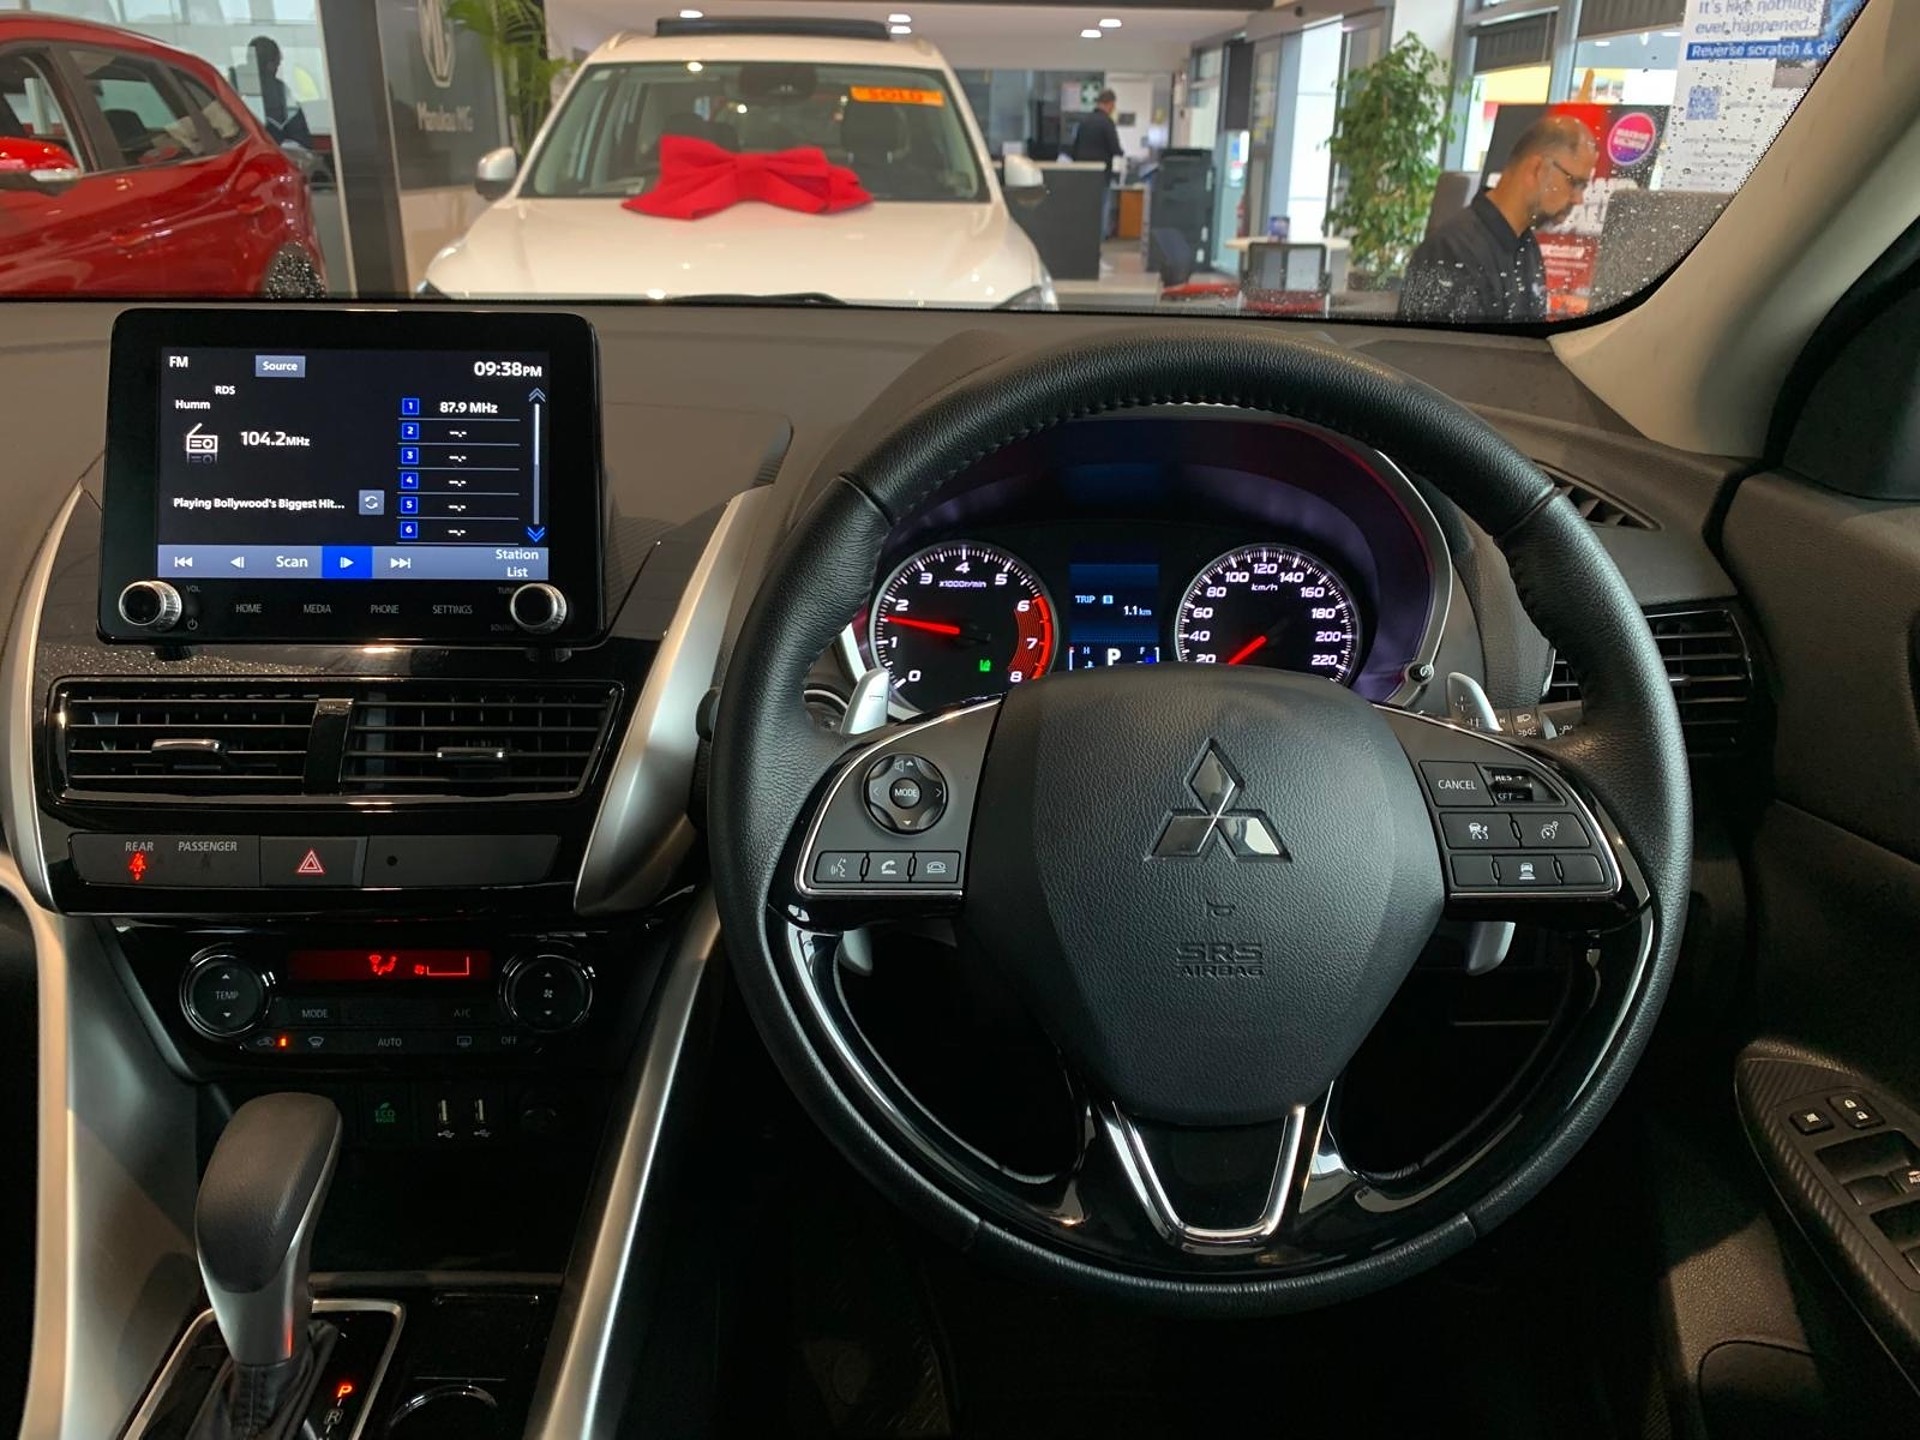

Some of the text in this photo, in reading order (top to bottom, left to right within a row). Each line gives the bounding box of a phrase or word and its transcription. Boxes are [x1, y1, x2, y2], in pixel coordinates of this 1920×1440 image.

[1692, 44, 1743, 58] Reverse
[1746, 40, 1799, 57] scratch
[169, 355, 189, 368] FM
[262, 360, 298, 371] Source
[215, 386, 236, 395] RDS
[175, 400, 211, 410] Humm
[440, 402, 467, 413] 87.9
[469, 402, 498, 413] MHz
[407, 426, 414, 435] 2
[407, 451, 413, 460] 3
[406, 476, 413, 484] 4
[173, 498, 211, 510] Playing
[213, 498, 277, 510] Bollywood's
[278, 499, 317, 511] Biggest
[406, 501, 413, 509] 5
[406, 526, 413, 534] 6
[495, 549, 539, 560] Station
[276, 556, 308, 568] Scan
[507, 567, 528, 577] List
[955, 562, 970, 574] 4
[1253, 563, 1278, 575] 120
[920, 573, 933, 585] 3
[994, 573, 1008, 585] 5
[1225, 572, 1250, 583] 100
[1280, 572, 1304, 583] 140
[1206, 587, 1227, 598] 80
[1251, 583, 1278, 592] km/h
[1300, 587, 1325, 598] 160
[1075, 595, 1096, 604] TRIP
[235, 603, 262, 613] HOME
[303, 604, 332, 614] MEDIA
[370, 604, 399, 614] PHONE
[432, 604, 473, 615] SETTINGS
[895, 600, 909, 612] 2
[1017, 600, 1030, 612] 6
[1124, 605, 1138, 615] 1.1
[1193, 607, 1213, 618] 60
[1311, 608, 1336, 619] 180
[1189, 630, 1210, 641] 40
[1315, 631, 1341, 642] 200
[890, 636, 898, 648] 1
[1026, 638, 1038, 649] 7
[1107, 648, 1122, 666] P
[1196, 654, 1216, 663] 20
[1311, 655, 1337, 665] 220
[908, 669, 921, 682] 0
[1010, 671, 1022, 682] 8
[1438, 779, 1477, 790] CANCEL
[894, 788, 918, 797] MODE
[125, 841, 154, 852] REAR
[178, 841, 238, 852] PASSENGER
[1176, 943, 1264, 963] SRS
[215, 990, 239, 1000] TEMP
[301, 1008, 328, 1019] MODE
[377, 1037, 402, 1048] AUTO
[501, 1036, 518, 1046] OFF
